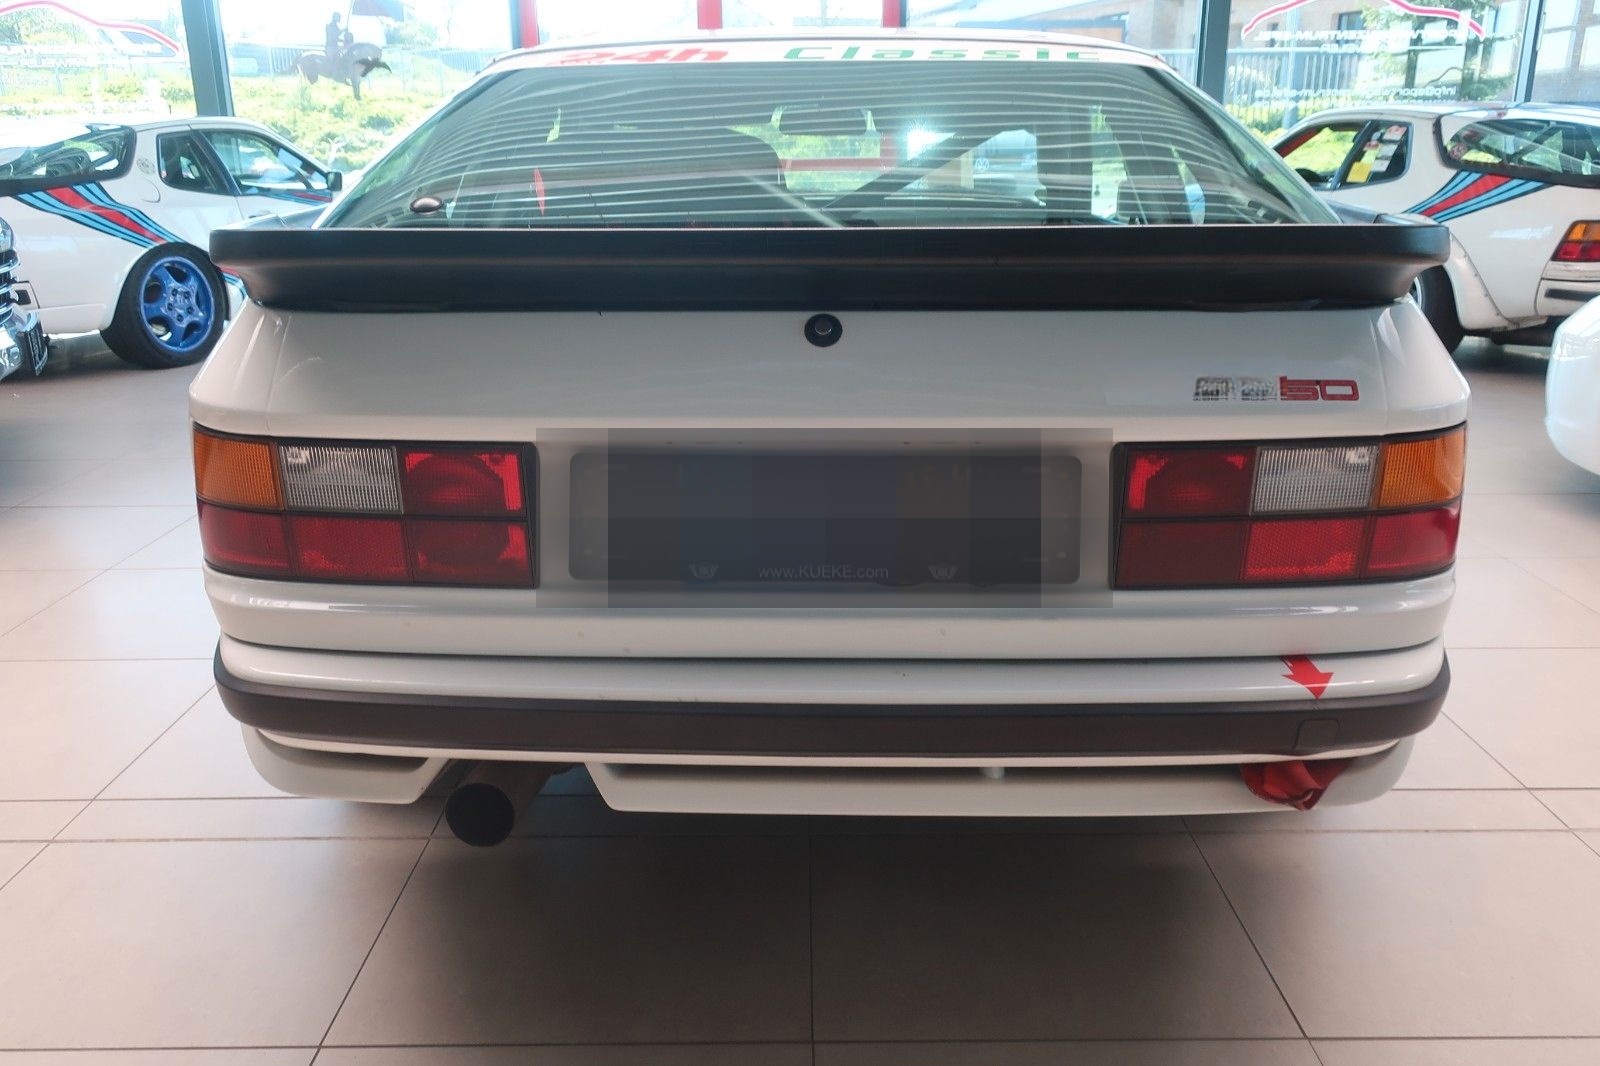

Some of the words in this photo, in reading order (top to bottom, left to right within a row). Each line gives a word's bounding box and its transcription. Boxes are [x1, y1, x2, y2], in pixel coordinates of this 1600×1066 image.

[557, 48, 729, 64] 24h
[783, 46, 1100, 60] Classic
[758, 564, 889, 579] www.KUEKE.com
